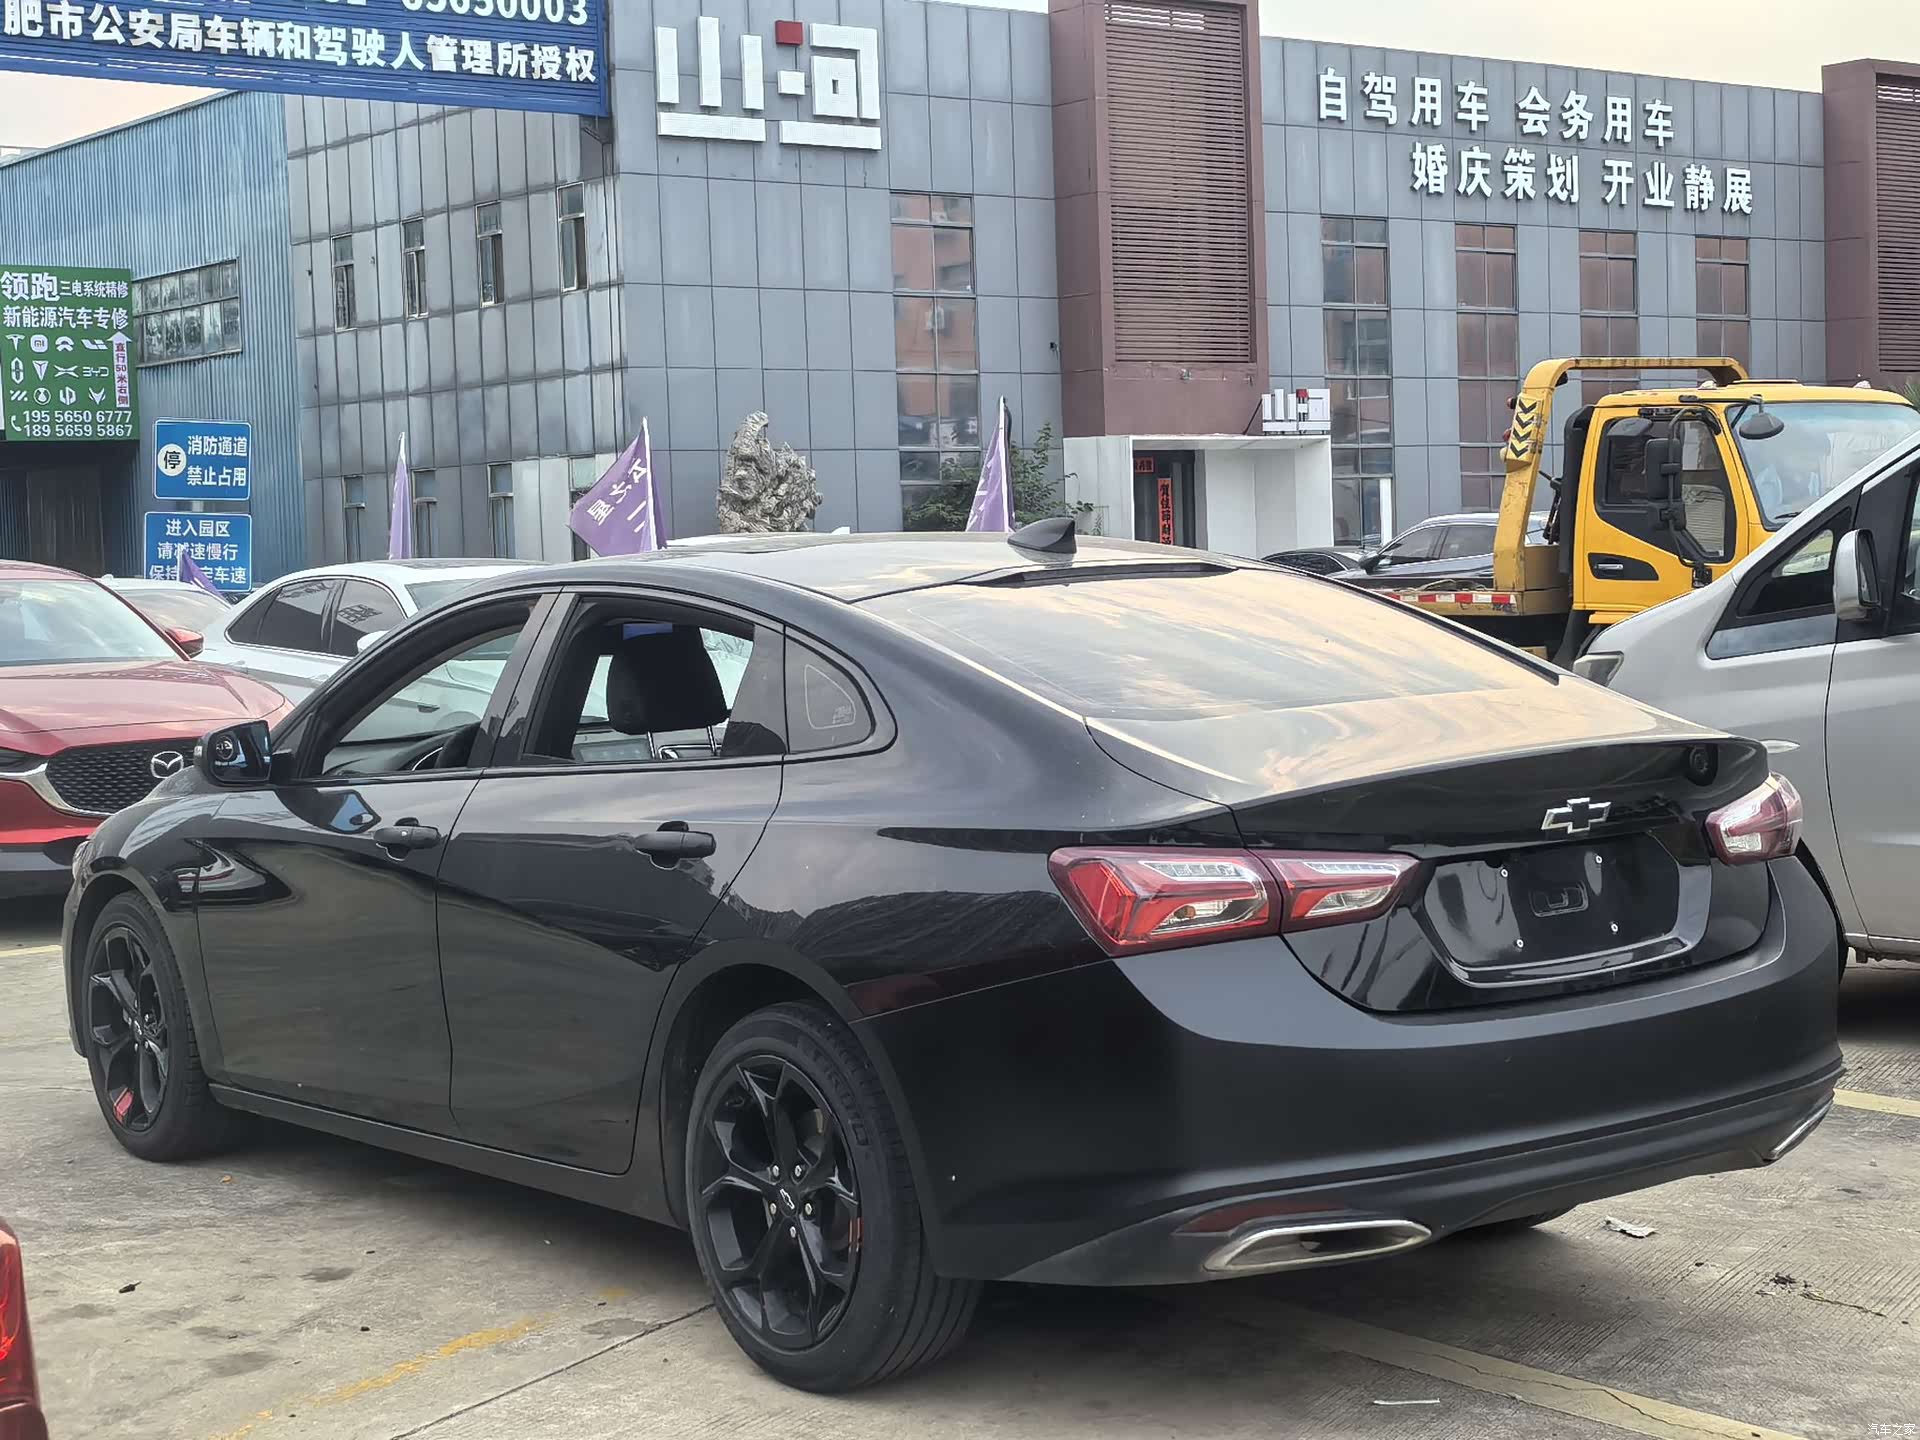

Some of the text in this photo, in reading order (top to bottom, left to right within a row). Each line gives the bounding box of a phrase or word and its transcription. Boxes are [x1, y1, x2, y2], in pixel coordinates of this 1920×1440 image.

[3, 0, 597, 83] 肥市公安局车辆和驾驶人管理所授权
[1319, 67, 1674, 147] 自驾用车 会务用车
[1411, 141, 1754, 214] 婚庆策划 开业静展
[0, 271, 129, 301] 领跑 三电系统精修
[3, 305, 129, 329] 新能源汽车专修
[23, 410, 132, 423] 195 5650 6777
[23, 424, 133, 437] 189 5659 5867
[187, 435, 248, 457] 消防通道
[163, 450, 181, 470] 停
[186, 465, 247, 487] 禁止占用
[165, 519, 231, 537] 进入园区
[149, 565, 246, 583] 保持定车速
